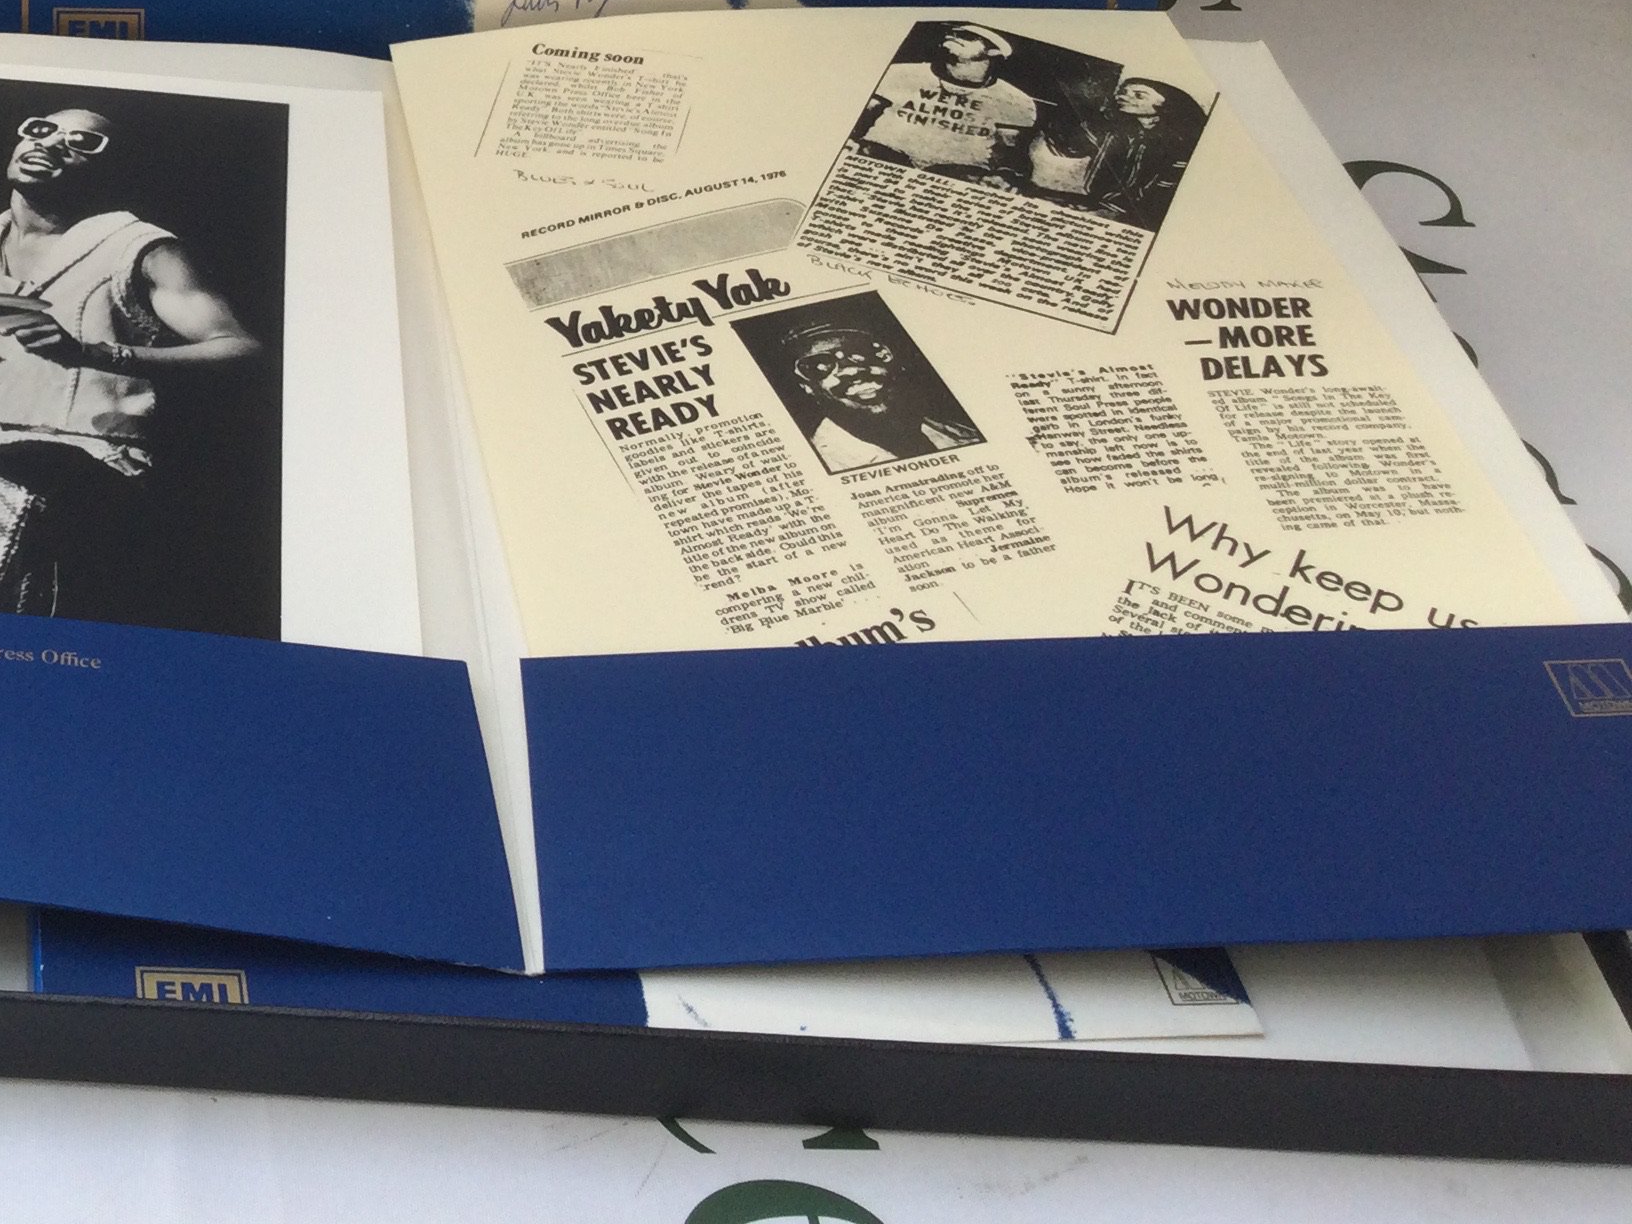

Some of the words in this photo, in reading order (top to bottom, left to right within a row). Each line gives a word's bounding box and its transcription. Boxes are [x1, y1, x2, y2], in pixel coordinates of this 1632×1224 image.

[532, 42, 601, 64] Coming
[604, 51, 645, 65] soon
[521, 219, 575, 239] RECORD
[578, 204, 631, 225] MIRROR
[634, 201, 645, 209] &
[684, 179, 739, 198] AUGUST
[760, 170, 787, 182] 1976
[544, 296, 715, 348] Yakety
[691, 268, 791, 310] Yak
[1166, 297, 1313, 321] WONDER
[1219, 325, 1317, 349] MORE
[572, 335, 713, 386] STEVIE'S
[1098, 363, 1154, 374] Almost
[1135, 370, 1159, 379] fact
[1200, 353, 1330, 381] DELAYS
[586, 363, 715, 414] NEARLY
[605, 393, 720, 441] READY
[695, 412, 764, 436] promotion
[624, 442, 674, 462] goodies
[680, 435, 706, 447] like
[628, 452, 673, 470] labels
[671, 447, 695, 458] and
[700, 433, 750, 452] stickers
[755, 428, 776, 438] are
[634, 462, 668, 479] given
[677, 456, 699, 466] out
[707, 450, 720, 459] to
[730, 436, 782, 453] coincide
[841, 466, 893, 485] STEVIE
[892, 454, 961, 474] WONDER
[850, 488, 881, 501] Joan
[884, 470, 965, 494] Armatrading
[967, 466, 985, 477] off
[987, 463, 1000, 471] to
[857, 492, 910, 510] America
[912, 489, 925, 498] to
[930, 477, 981, 496] promote
[983, 472, 1005, 482] her
[949, 488, 974, 500] new
[980, 480, 1012, 494] A&M
[878, 531, 917, 546] Heart
[920, 526, 940, 537] Do
[943, 520, 969, 532] The
[904, 565, 957, 583] Jackson
[961, 561, 975, 570] to
[980, 555, 998, 566] be
[1003, 553, 1012, 561] a
[1017, 543, 1056, 558] father
[1163, 505, 1271, 568] Why
[1289, 549, 1404, 615] keep
[726, 584, 778, 602] Melba
[787, 569, 839, 586] Moore
[849, 563, 864, 572] is
[759, 612, 790, 628] Blue
[1167, 592, 1211, 612] BEEN
[1216, 610, 1254, 628] some
[41, 649, 102, 669] Office
[156, 980, 229, 1005] EMI
